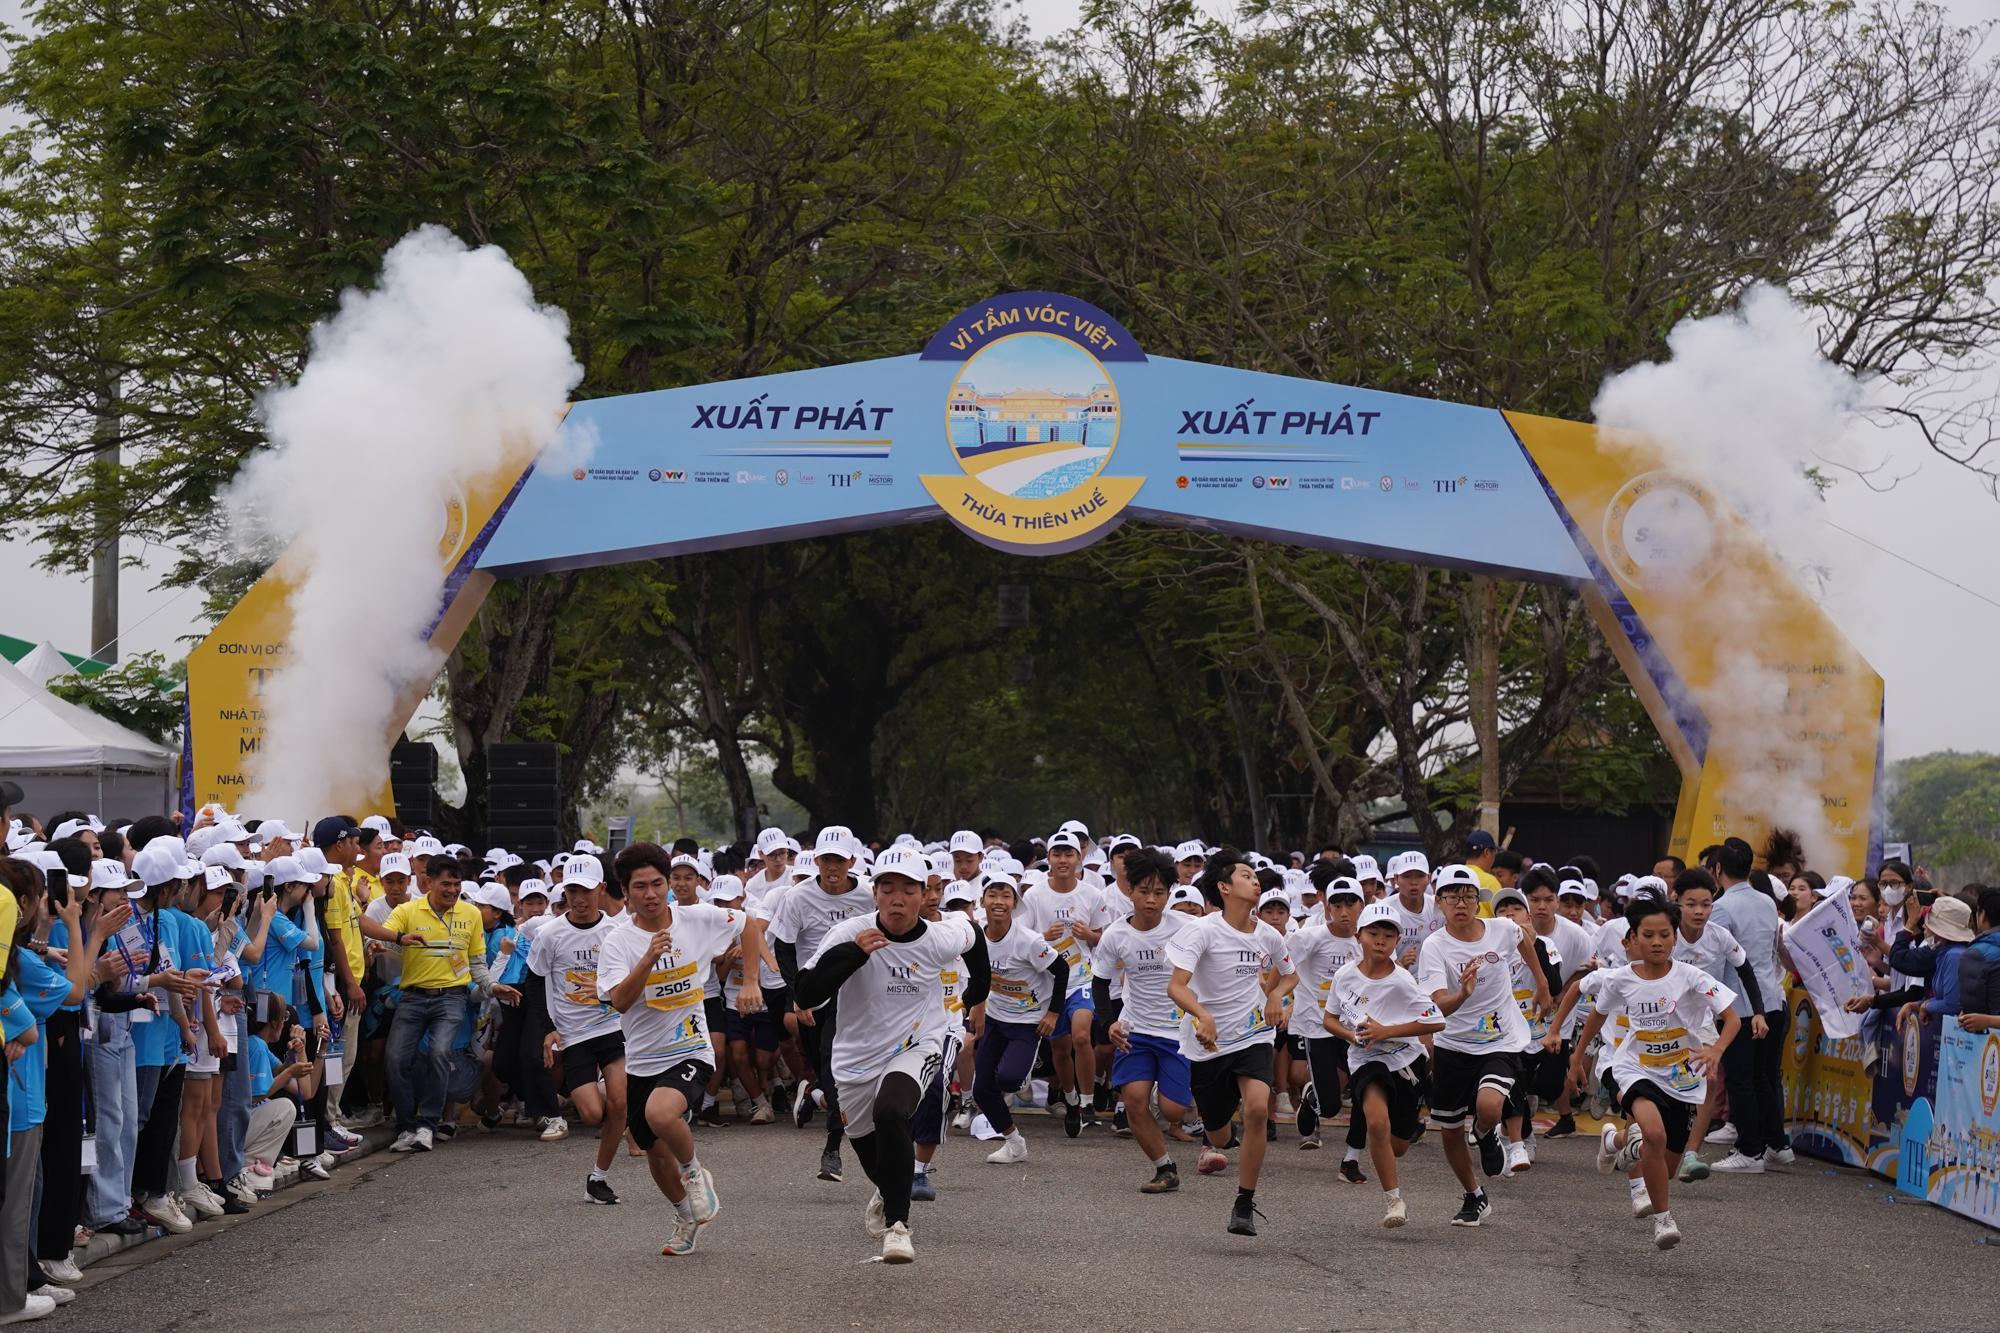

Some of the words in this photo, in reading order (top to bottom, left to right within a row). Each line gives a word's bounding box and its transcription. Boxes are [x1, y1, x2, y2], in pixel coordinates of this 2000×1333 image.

[950, 328, 974, 352] VÌ
[971, 306, 1020, 337] TẦM
[1024, 303, 1071, 327] VÓC
[1074, 315, 1118, 351] VIỆT
[691, 392, 790, 430] XUẤT
[793, 399, 894, 431] PHÁT
[1177, 397, 1277, 435] XUẤT
[1280, 403, 1381, 436] PHÁT
[665, 471, 684, 480] VTV
[828, 473, 851, 487] TH
[1269, 478, 1288, 486] VTV
[1433, 479, 1456, 493] TH
[960, 492, 1007, 527] THỪA
[1012, 513, 1069, 530] THIÊN
[1071, 486, 1109, 521] HUẾ
[218, 643, 248, 655] ĐƠN
[250, 643, 263, 656] VỊ
[219, 709, 249, 721] NHÀ
[216, 775, 245, 786] NHÀ
[825, 832, 839, 841] TH
[882, 852, 902, 865] TH
[569, 863, 583, 874] TH
[828, 910, 845, 921] TH
[1054, 909, 1070, 919] TH
[1373, 907, 1390, 916] TH
[1404, 927, 1417, 936] TH
[573, 949, 592, 960] TH
[1136, 950, 1155, 960] TH
[1331, 955, 1346, 965] TH
[654, 956, 675, 971] TH
[889, 966, 911, 979] TH
[655, 979, 691, 997] 2505
[887, 985, 920, 993] MISTORI
[1082, 988, 1091, 999] 6
[1421, 1005, 1436, 1017] VTV
[1637, 1001, 1659, 1014] TH
[1639, 1018, 1668, 1027] MISTORI
[1646, 1040, 1680, 1054] 2394
[681, 1063, 698, 1082] 3
[1906, 1138, 1924, 1188] TH
